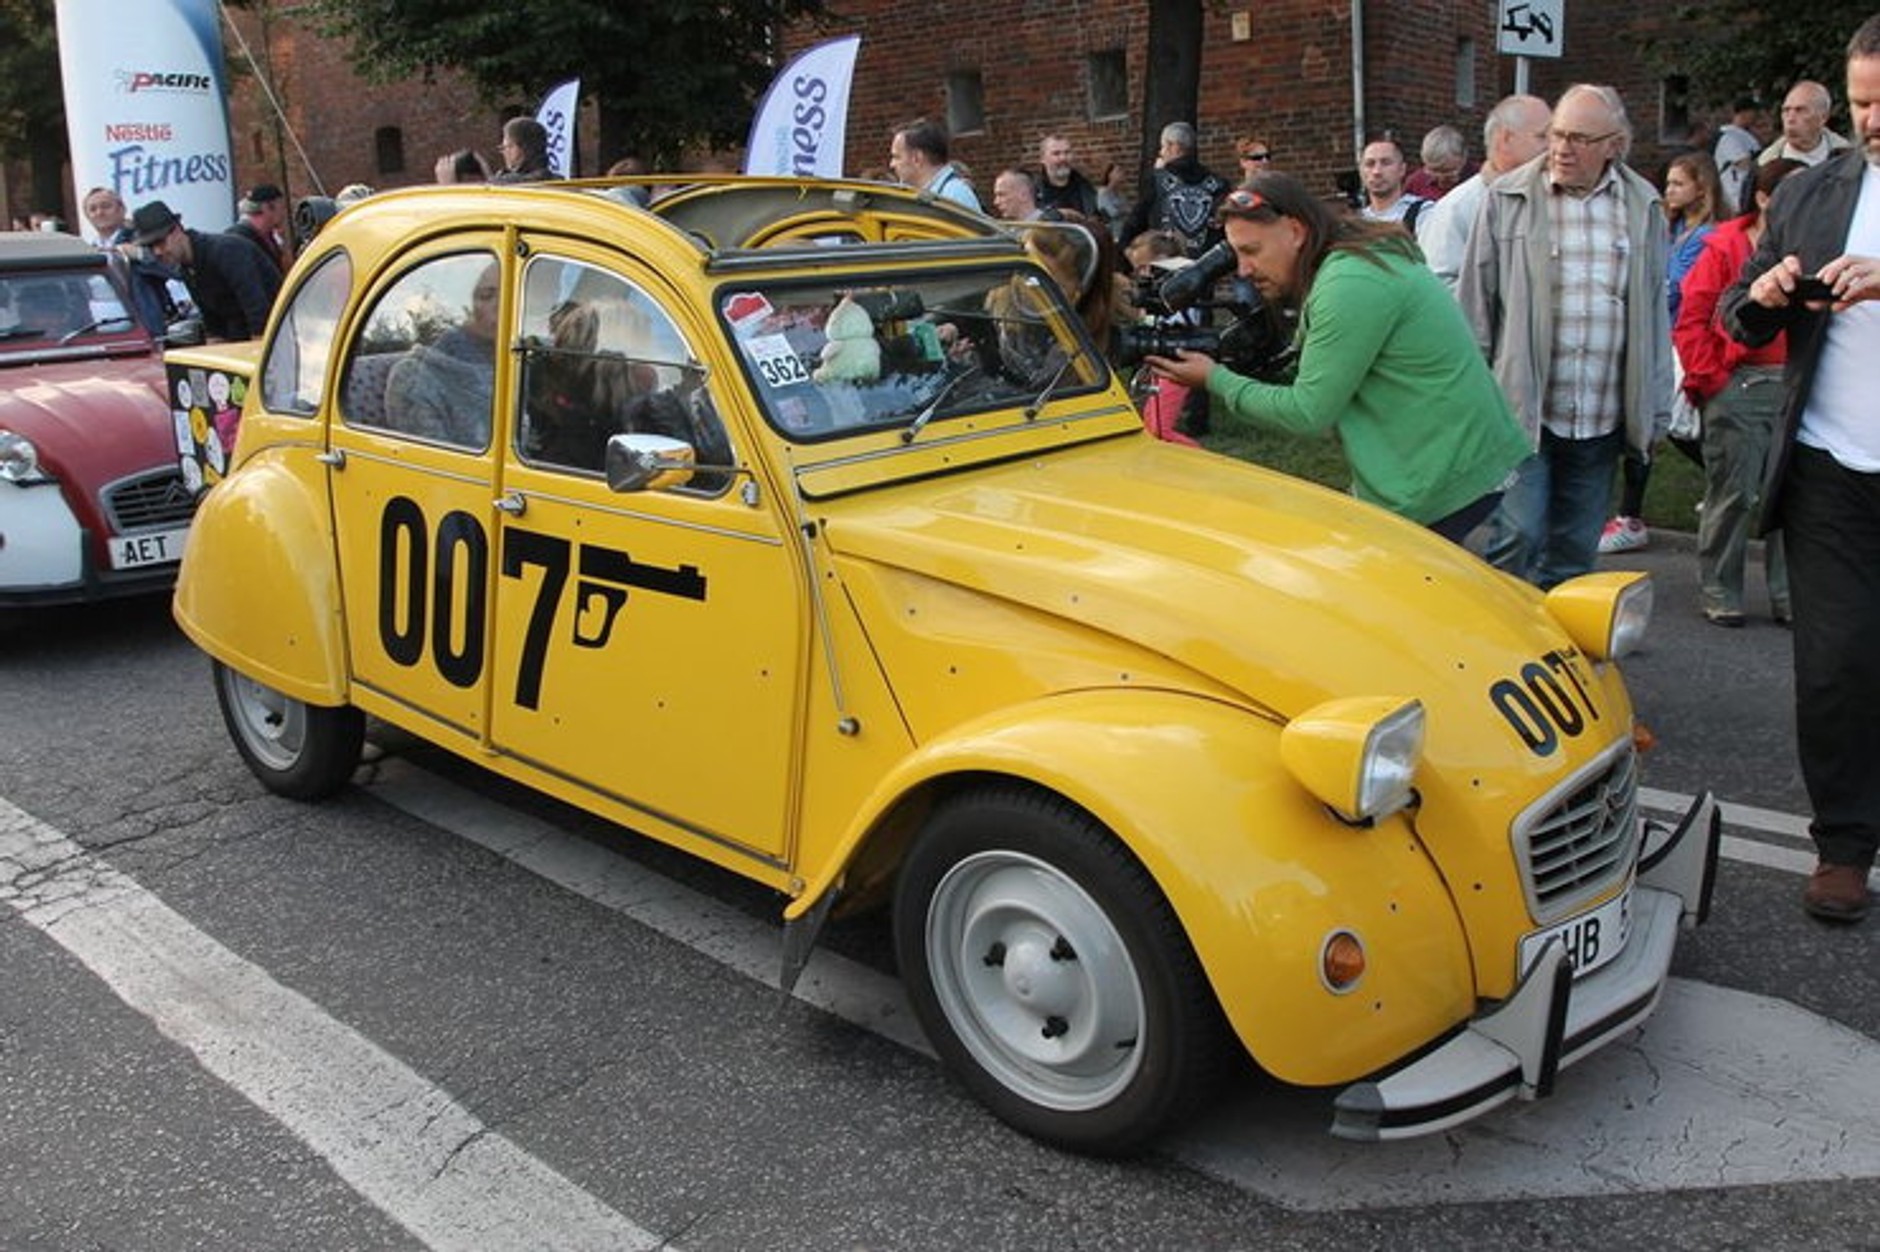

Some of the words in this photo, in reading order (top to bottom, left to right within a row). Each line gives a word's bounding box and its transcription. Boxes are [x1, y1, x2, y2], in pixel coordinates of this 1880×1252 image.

[108, 144, 228, 195] Fitness
[759, 355, 806, 385] 362
[125, 535, 167, 564] AET
[379, 495, 571, 712] 007
[1489, 650, 1599, 758] 007
